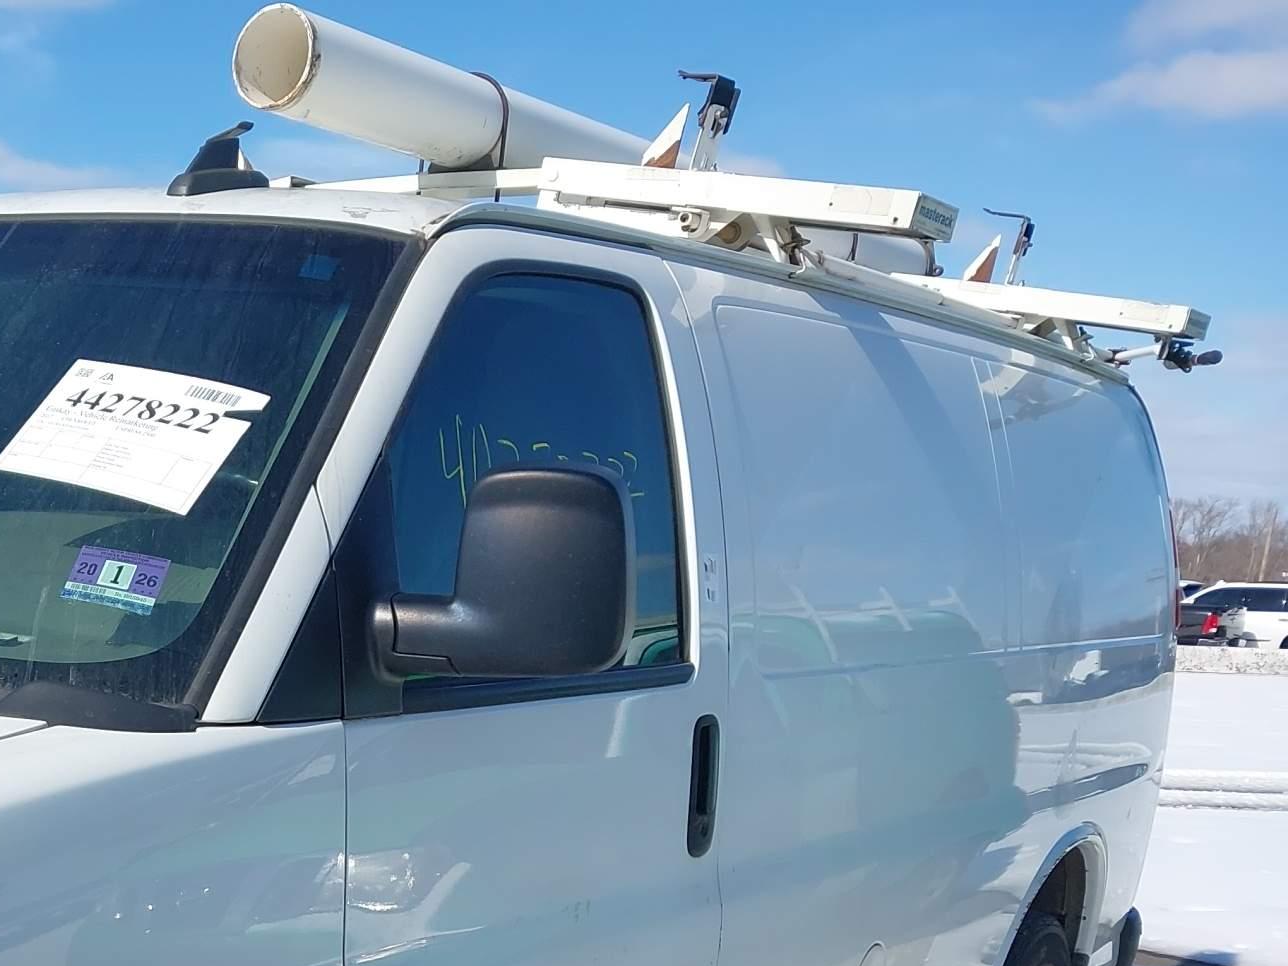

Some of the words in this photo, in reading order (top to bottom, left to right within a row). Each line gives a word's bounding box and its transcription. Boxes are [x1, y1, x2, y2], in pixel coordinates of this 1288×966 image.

[919, 205, 953, 228] masterack
[65, 387, 220, 435] 44278222
[77, 561, 98, 576] 20
[109, 564, 124, 585] 1
[134, 572, 159, 588] 26
